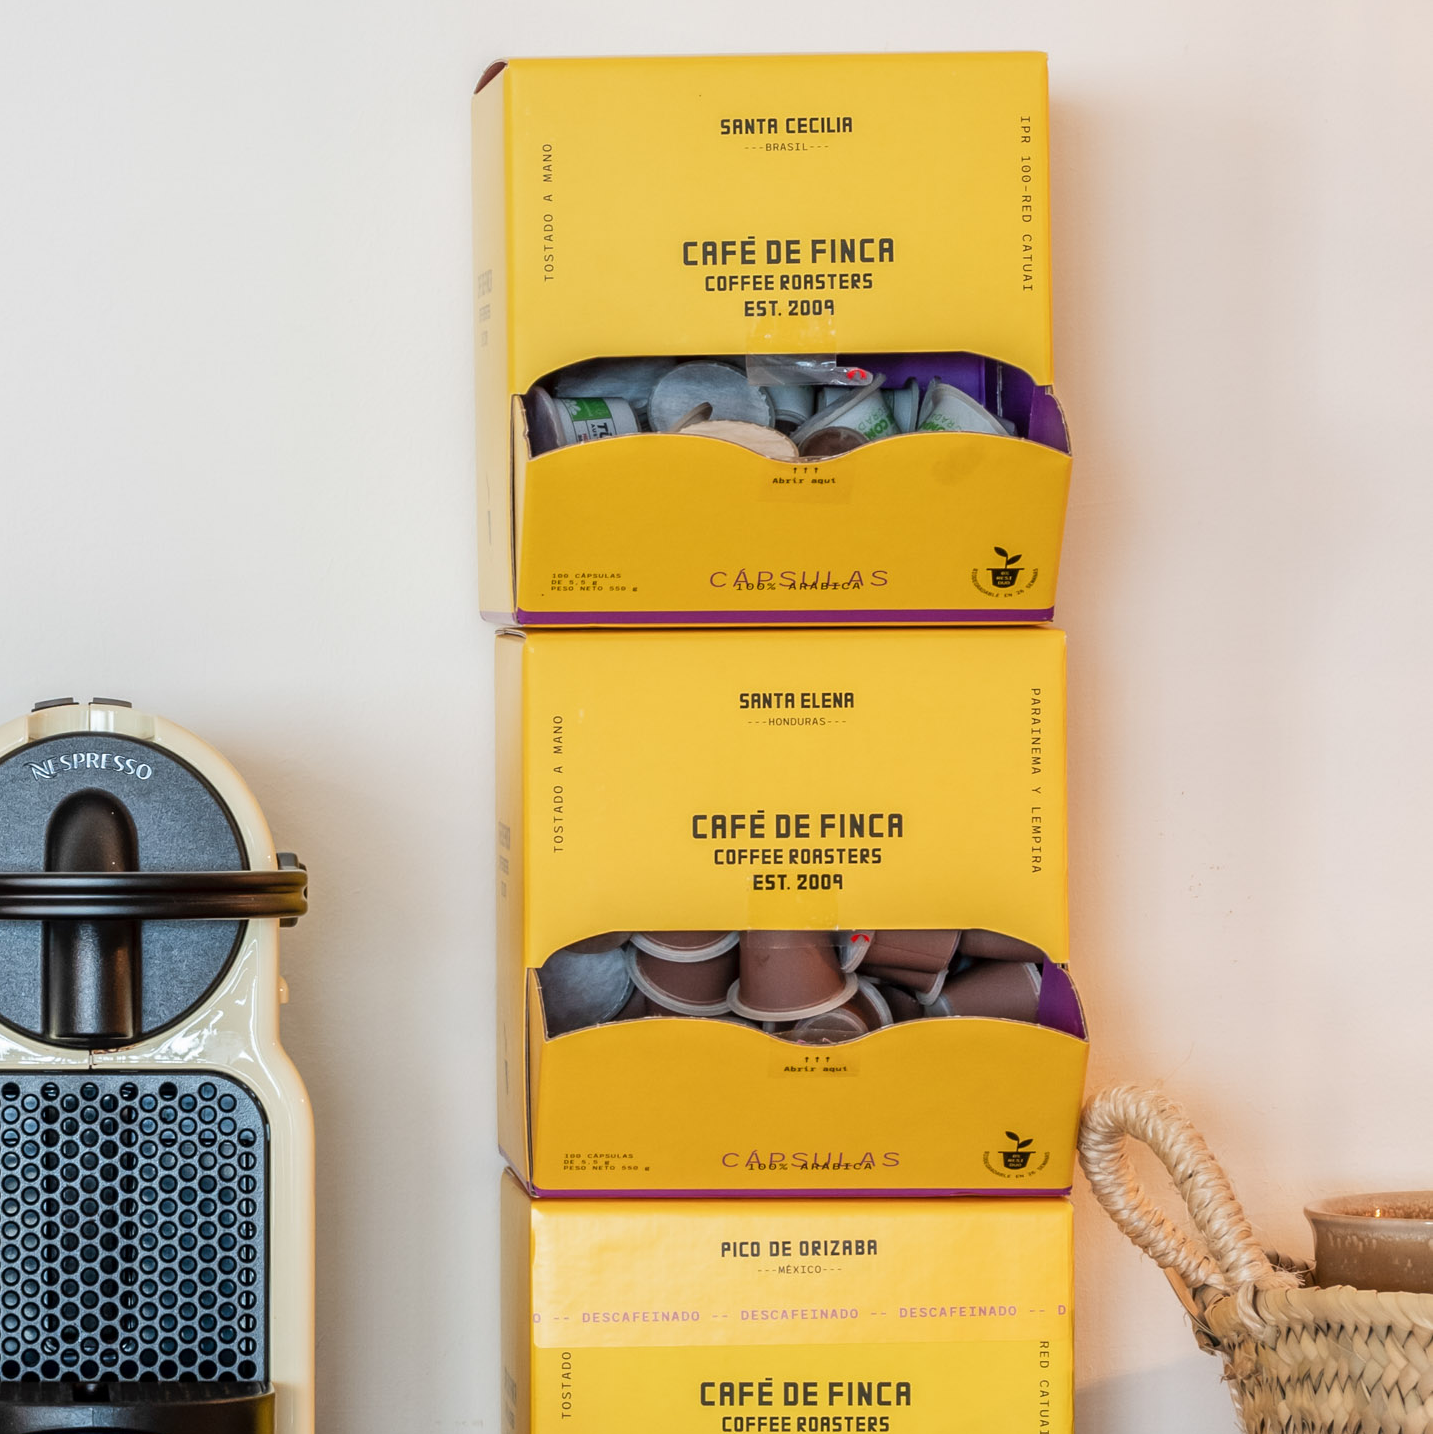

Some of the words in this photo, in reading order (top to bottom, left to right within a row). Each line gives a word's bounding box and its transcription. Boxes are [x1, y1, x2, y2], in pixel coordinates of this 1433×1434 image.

[721, 119, 777, 134] SANTA
[786, 117, 852, 133] CECILIA
[1021, 117, 1030, 143] IPR
[543, 144, 552, 182] MANO
[1021, 157, 1031, 222] 100-RED
[544, 214, 554, 281] TOSTADO
[683, 236, 755, 265] CAFÉ
[767, 240, 800, 264] DE
[812, 238, 893, 263] FINCA
[706, 275, 774, 291] COFFEE
[780, 273, 872, 290] ROASTERS
[745, 301, 781, 316] EST.
[789, 300, 834, 316] 2009
[710, 568, 889, 588] CÁPSULAS
[740, 693, 794, 708] SANTA
[801, 693, 854, 708] ELENA
[553, 716, 562, 753] MANO
[1031, 689, 1041, 774] PARAINEMA
[24, 752, 152, 781] NESPRESSO
[554, 786, 563, 852] TOSTADO
[693, 810, 764, 838] CAFÉ
[776, 814, 809, 838] DE
[821, 814, 902, 838] FINCA
[1032, 807, 1041, 872] LEMPIRA
[715, 849, 783, 864] COFFEE
[789, 848, 881, 864] ROASTERS
[754, 875, 790, 890] EST.
[797, 874, 842, 890] 2009
[722, 1149, 900, 1167] CÁPSULAS
[722, 1242, 760, 1257] PICO
[770, 1241, 791, 1256] DE
[800, 1240, 877, 1256] ORIZABA
[582, 1311, 699, 1322] DESCAFEINADO
[741, 1309, 858, 1320] DESCAFEINADO
[900, 1306, 1016, 1318] DESCAFEINADO
[1040, 1342, 1049, 1368] RED
[562, 1352, 571, 1419] TOSTADO
[701, 1378, 772, 1406] CAFÉ
[784, 1382, 817, 1406] DE
[829, 1382, 910, 1406] FINCA
[723, 1417, 791, 1432] COFFEE
[797, 1417, 889, 1432] ROASTERS
